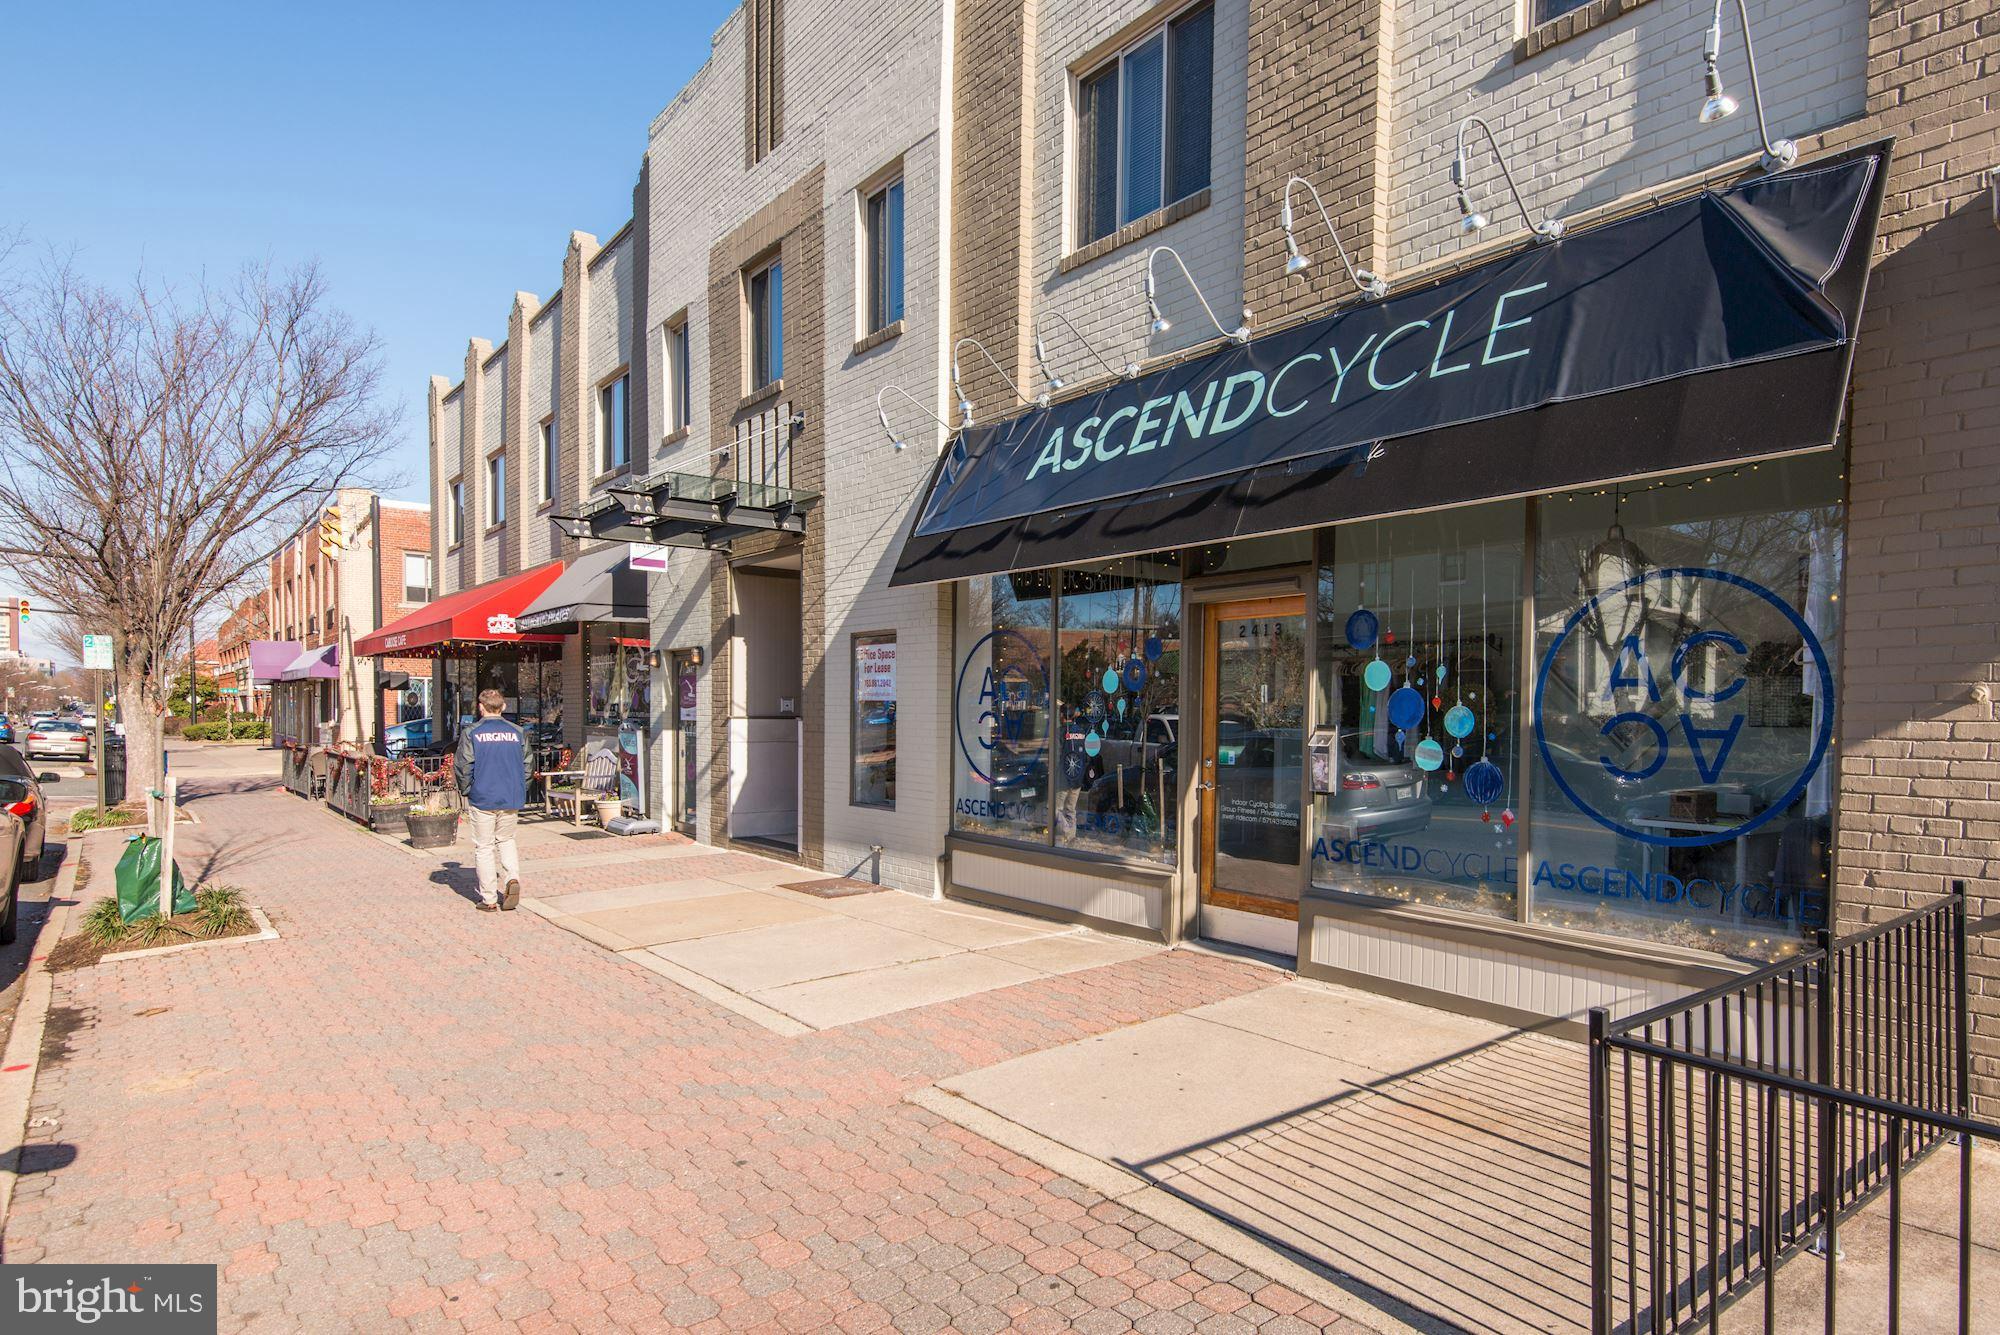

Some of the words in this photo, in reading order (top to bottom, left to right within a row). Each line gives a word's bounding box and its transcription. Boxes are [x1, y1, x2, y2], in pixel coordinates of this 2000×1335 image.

[1025, 282, 1548, 481] ASCENDCYCLE
[1239, 622, 1282, 638] 2413
[85, 636, 93, 647] 2
[877, 648, 896, 661] Space
[874, 662, 892, 673] Lease
[474, 732, 519, 742] VIRGINIA
[956, 798, 1049, 823] ASCENDCYCLE
[1249, 799, 1269, 809] Cycling
[1269, 801, 1287, 809] Studio
[1220, 805, 1236, 813] Group
[1237, 806, 1256, 815] Fitness
[1260, 808, 1280, 817] Private
[1280, 810, 1299, 819] Events
[1312, 837, 1518, 884] ASCENDCYCLE
[1532, 860, 1825, 923] ASCENDCYCLE
